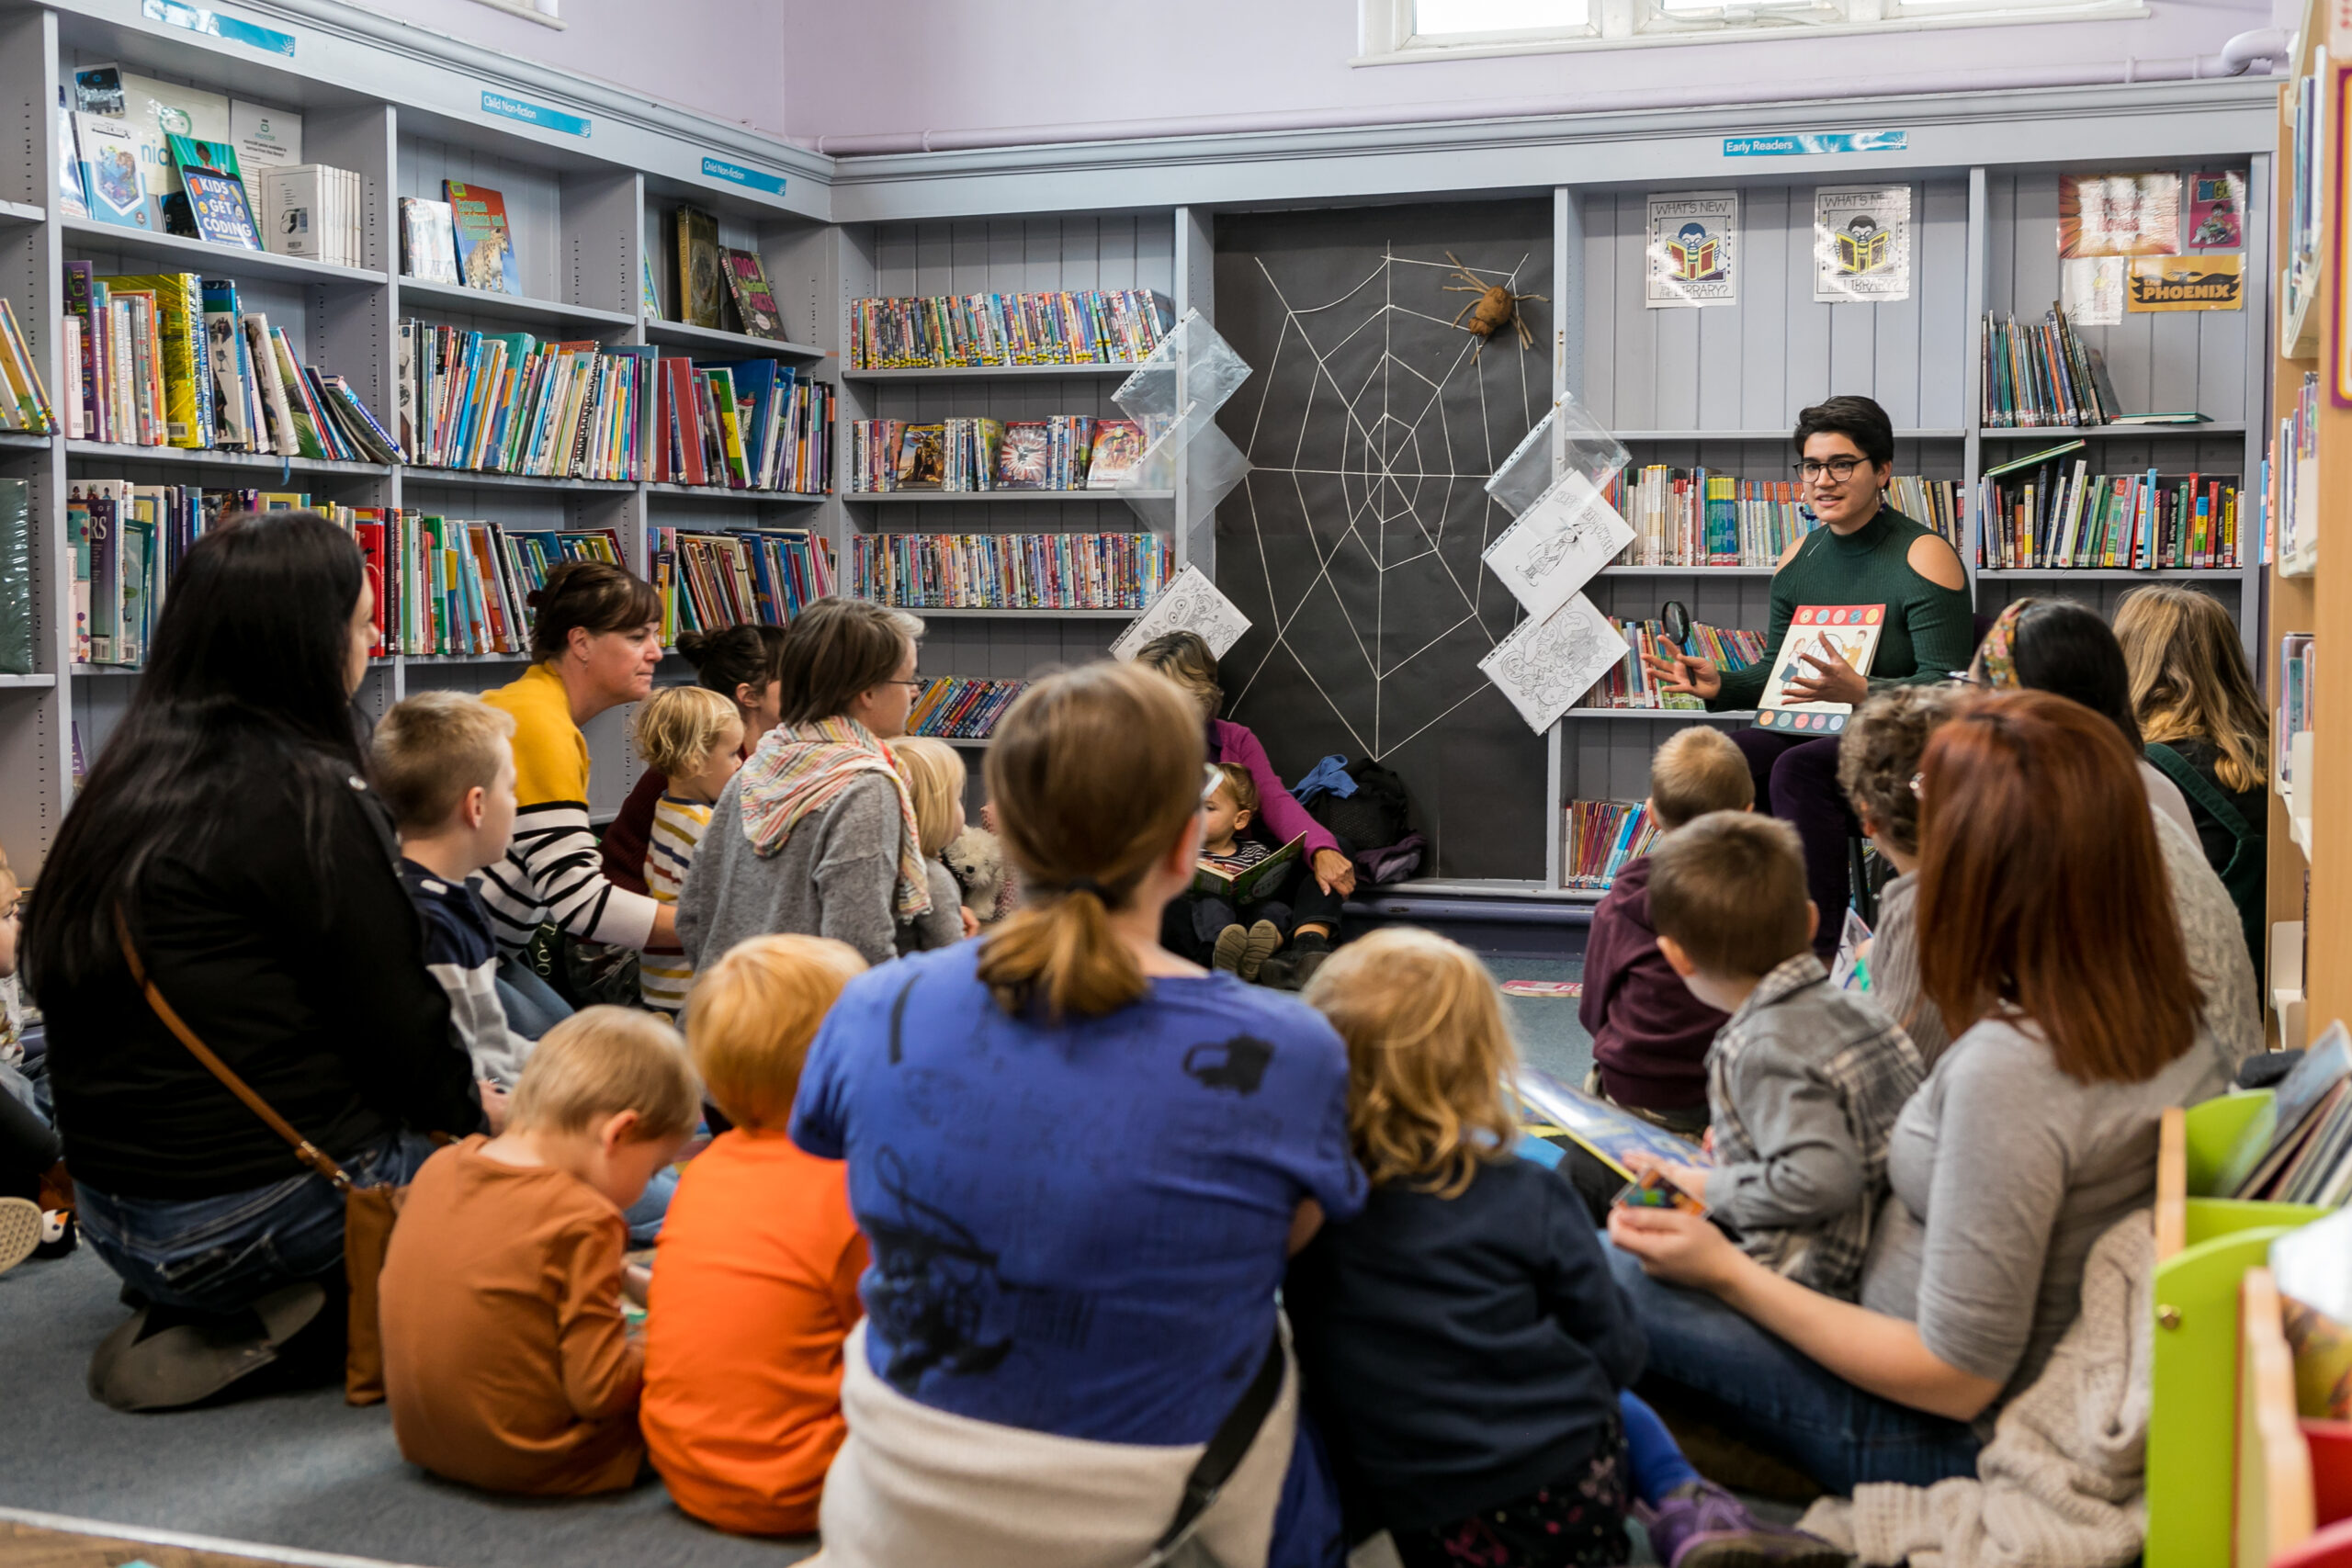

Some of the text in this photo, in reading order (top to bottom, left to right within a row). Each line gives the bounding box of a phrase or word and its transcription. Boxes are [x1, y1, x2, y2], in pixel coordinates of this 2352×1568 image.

[483, 95, 537, 119] Child Non-fiction
[1726, 140, 1793, 153] Early Readers
[704, 160, 745, 180] Child Non-fiction
[199, 177, 229, 195] KIDS
[209, 198, 232, 215] GET
[1656, 201, 1727, 215] WHAT'S NEW
[1825, 194, 1867, 207] WHAT'S
[203, 217, 253, 238] CODING
[2143, 278, 2162, 287] the
[2143, 284, 2230, 300] PHOENIX
